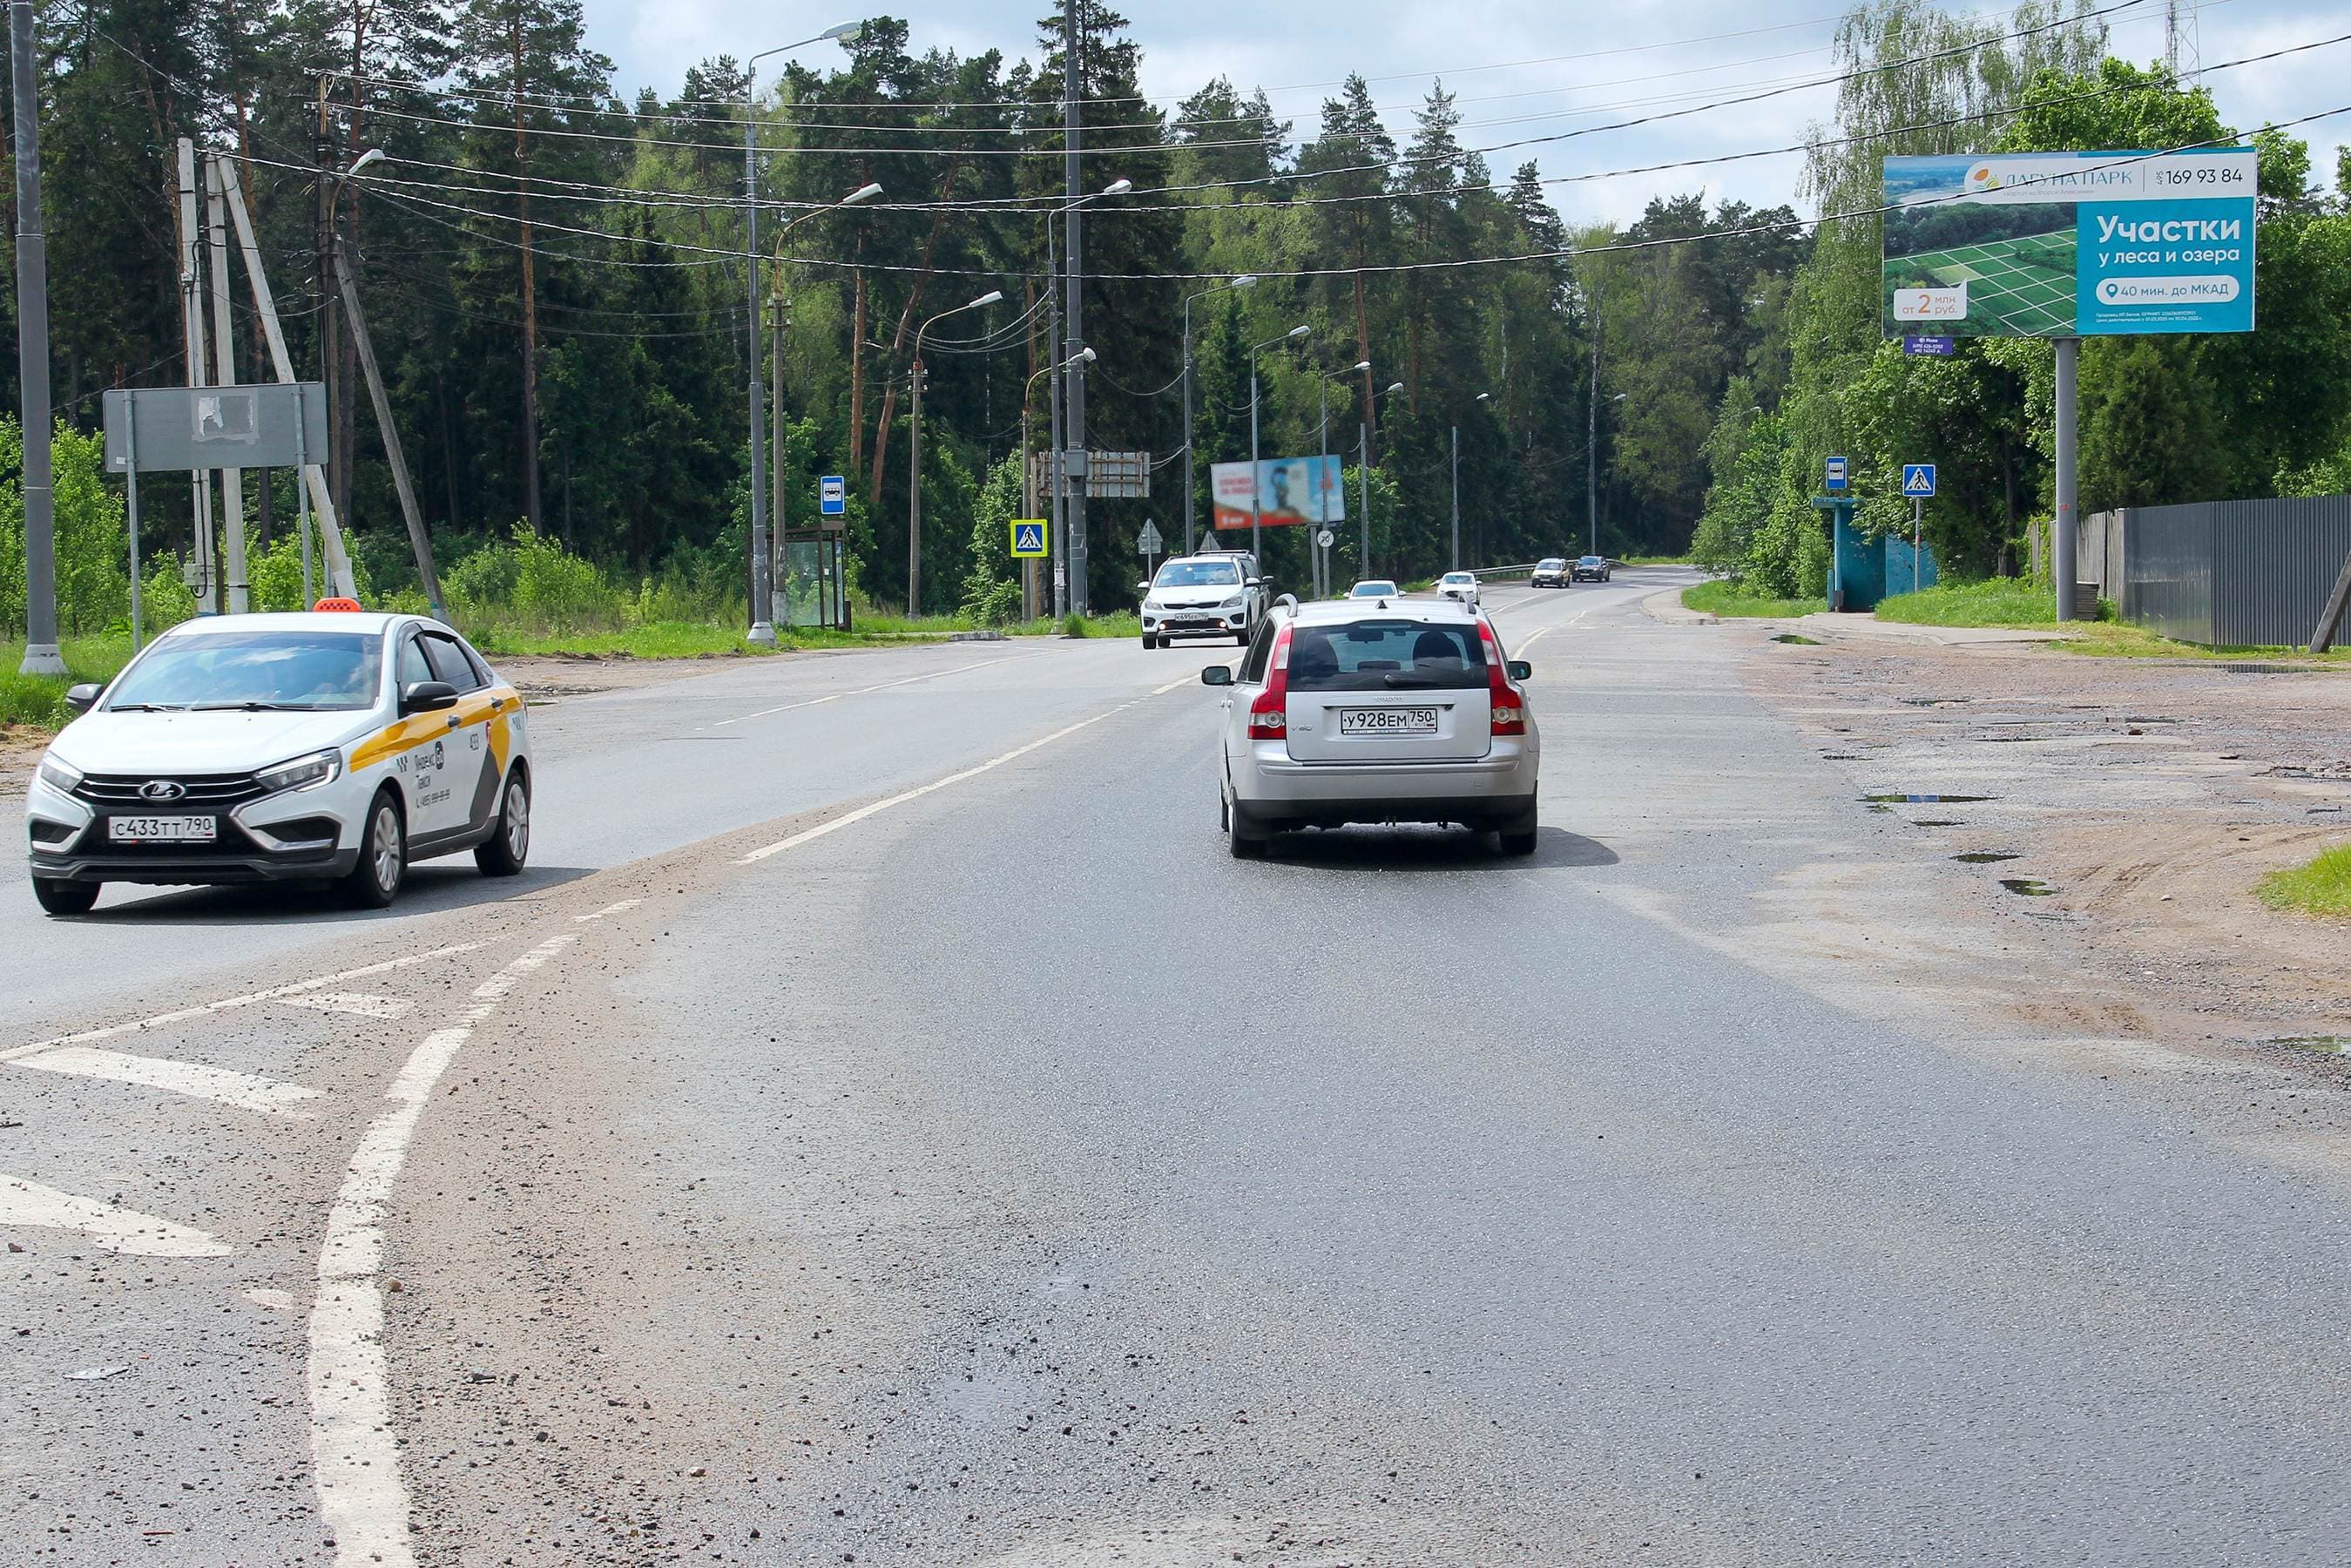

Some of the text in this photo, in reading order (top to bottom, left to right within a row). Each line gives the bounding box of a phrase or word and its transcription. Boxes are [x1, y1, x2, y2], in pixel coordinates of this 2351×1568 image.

[2006, 171, 2132, 186] ЛАГУНА ПАРК
[2165, 167, 2243, 185] 169 93 84
[2097, 214, 2240, 244] Участки
[2098, 248, 2240, 268] у леса и озера
[2120, 283, 2229, 298] 40 мин. до МКАД
[1918, 294, 1931, 314] 2
[1935, 304, 1957, 315] руб.
[1348, 710, 1433, 728] У928ЕМ 750
[115, 818, 212, 836] С433ТТ 790
